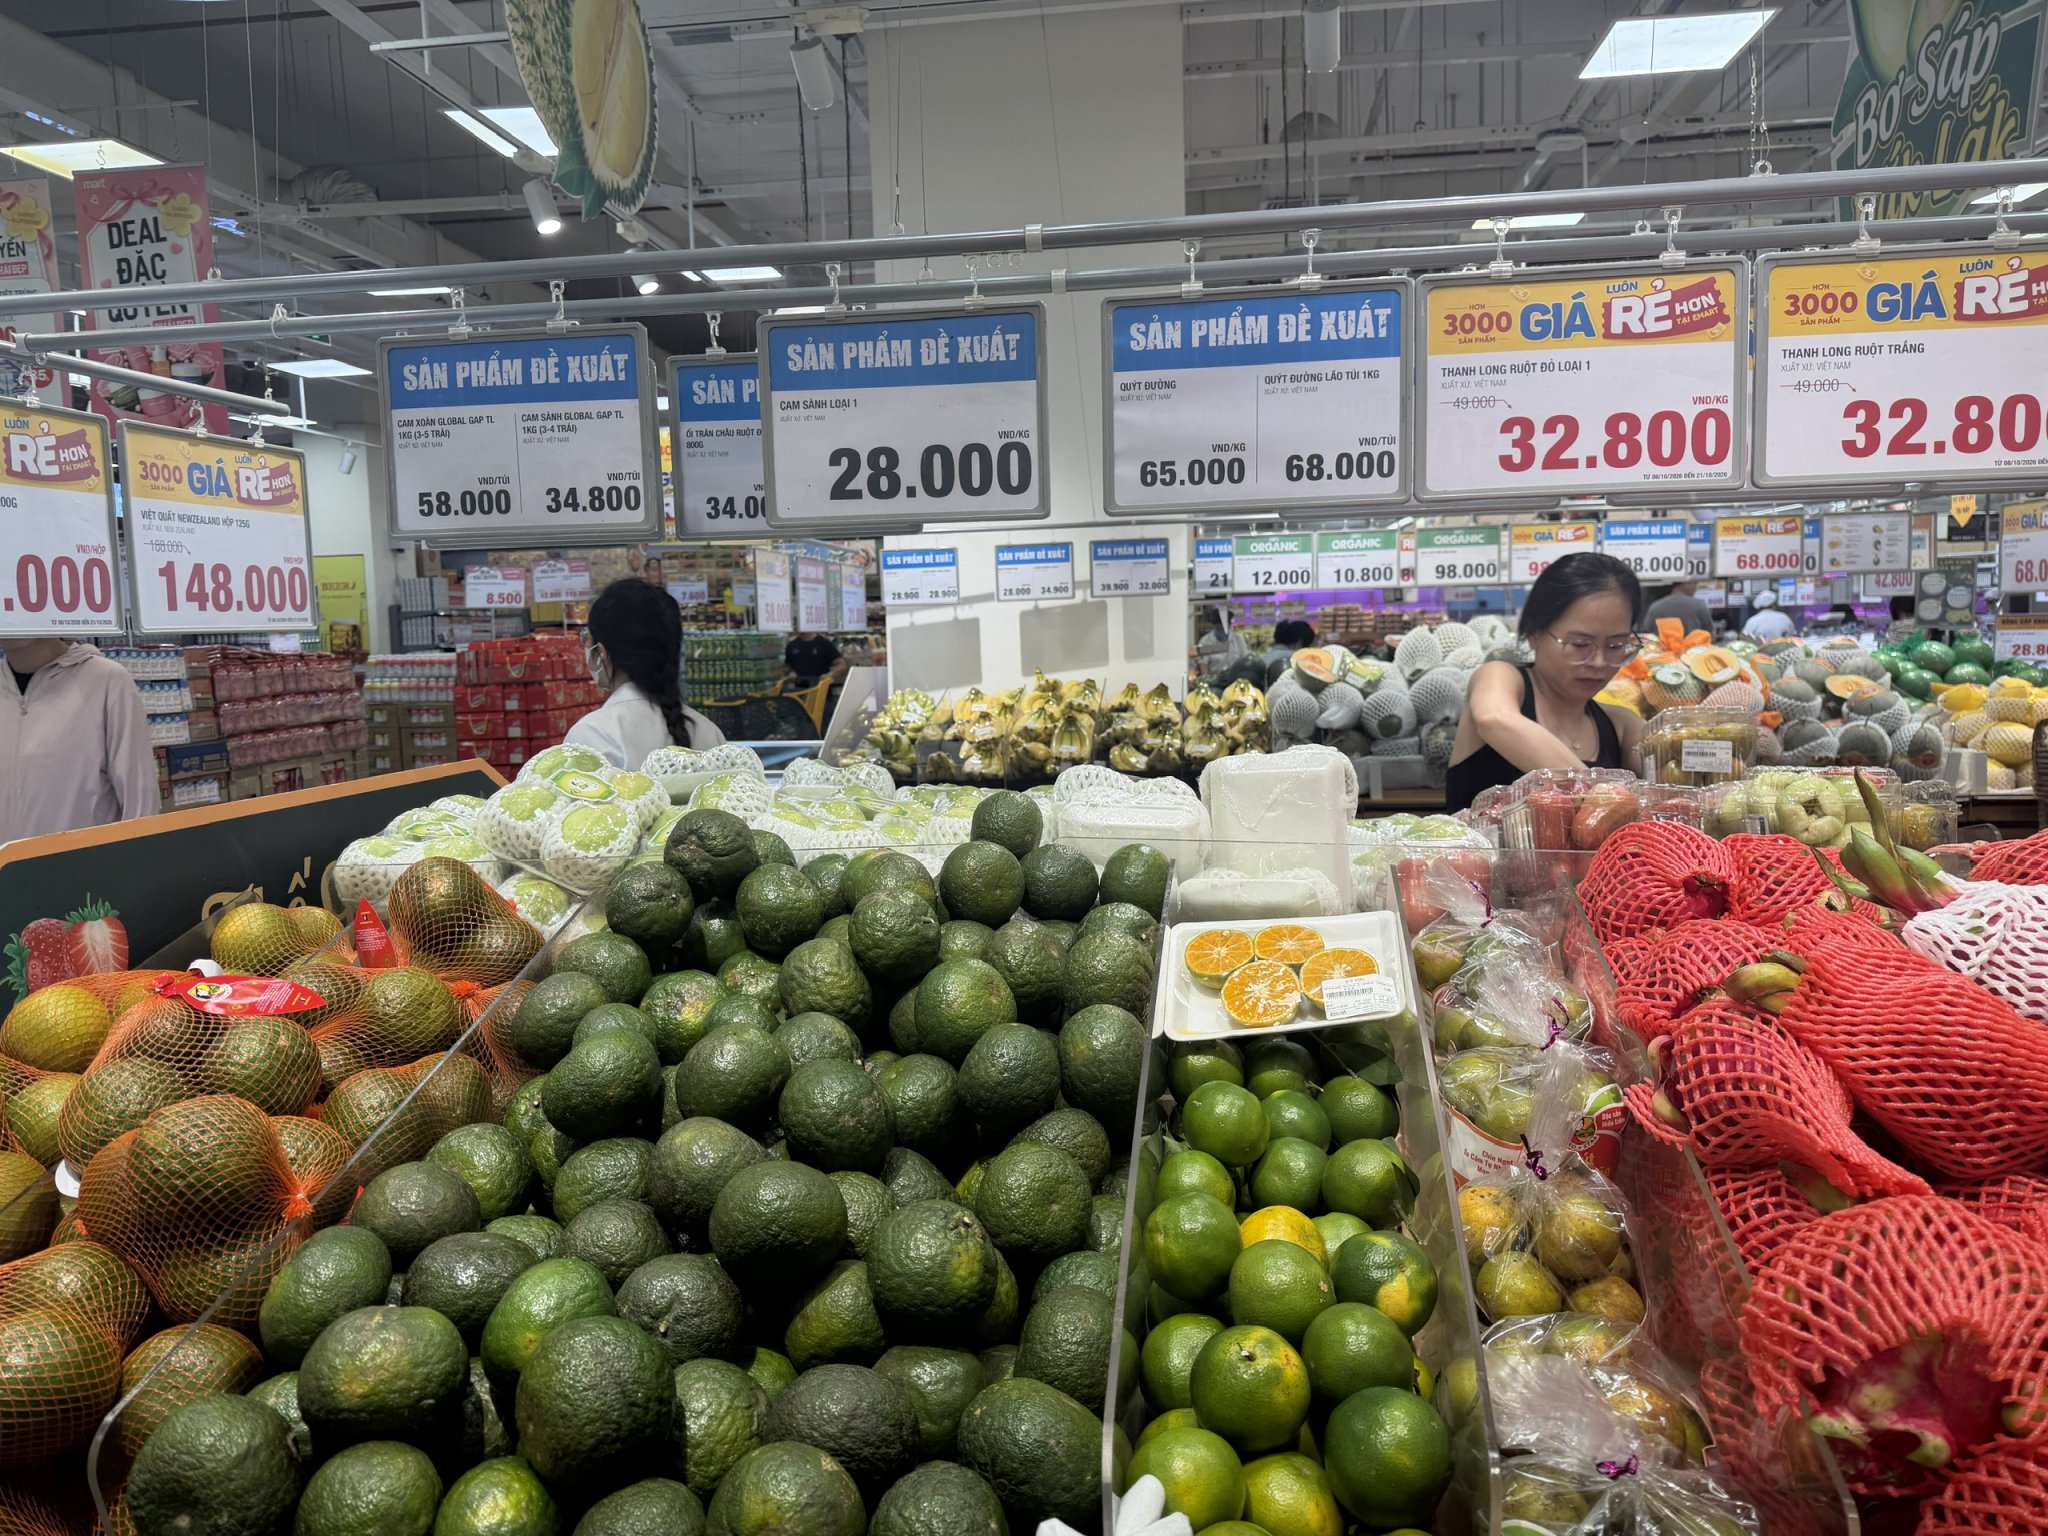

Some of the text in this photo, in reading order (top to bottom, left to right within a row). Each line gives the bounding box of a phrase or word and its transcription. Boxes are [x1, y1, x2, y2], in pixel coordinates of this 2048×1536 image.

[1855, 9, 2000, 168] Bơ Sáp
[107, 215, 168, 250] DEAL
[116, 249, 167, 286] ĐẶC
[1959, 258, 1994, 274] LUÔN
[1606, 280, 1639, 295] LUÔN
[1812, 283, 1830, 291] HƠN
[1962, 255, 2030, 316] RẺ
[1675, 292, 1716, 316] HƠN
[1866, 269, 1948, 323] GIÁ
[1468, 303, 1486, 311] HƠN
[1610, 277, 1673, 335] RẺ
[1519, 291, 1597, 341] GIÁ
[1676, 306, 1719, 327] TẠI EMART
[1799, 315, 1841, 326] SẢN PHẨM
[1129, 299, 1392, 351] SẢN PHẨM ĐỀ XUẤT
[787, 324, 1021, 373] SẢN PHẨM ĐỀ XUẤT
[1458, 335, 1496, 345] SẢN PHẨM
[1782, 340, 1926, 360] THANH LONG RUỘT TRẮNG
[403, 345, 628, 391] SẢN PHẨM ĐỀ XUẤT
[1441, 358, 1591, 378] THANH LONG RUỘT ĐỎ LOẠI 1
[1780, 361, 1799, 372] XUẤT
[1816, 360, 1833, 372] VIỆT
[1834, 360, 1851, 370] NAM
[1120, 378, 1177, 392] QUÝT ĐƯỜNG
[1264, 372, 1289, 386] QUÝT
[1289, 370, 1323, 384] ĐƯỜNG
[1344, 367, 1360, 380] TÚI
[1361, 369, 1380, 380] 1KG
[1440, 379, 1459, 390] XUẤT
[1474, 378, 1489, 389] VIỆT
[1490, 378, 1507, 388] NAM
[692, 373, 735, 406] SẢN
[1793, 378, 1840, 394] 49.000
[780, 396, 858, 413] CAM SÀNH LOẠI 1
[1453, 395, 1496, 410] 49.000
[1691, 395, 1729, 407] VND/KG
[4, 418, 29, 430] LUÔN
[397, 415, 496, 428] CAM XOÀN GLOBAL GAP TL
[521, 410, 625, 422] CAM SÀNH GLOBAL GAP TL
[521, 422, 579, 435] 1KG (3-4 TRÁI)
[715, 427, 735, 438] CHÂU
[736, 427, 755, 440] RUỘT
[1840, 393, 2048, 459] 32.80
[398, 431, 413, 440] 1KG
[413, 430, 430, 441] (3-5
[998, 429, 1030, 441] VND/KG
[1358, 434, 1397, 448] VND/TÚI
[1498, 408, 1732, 474] 32.800
[8, 420, 57, 476] RẺ
[58, 443, 89, 463] HƠN
[686, 440, 704, 449] 800G
[1211, 442, 1246, 454] VND/KG
[235, 453, 252, 464] LUÔN
[1285, 450, 1397, 482] 68.000
[186, 457, 233, 499] GIÁ
[238, 455, 273, 501] RẺ
[477, 472, 511, 486] VND/TÚI
[606, 468, 642, 482] VND/TÚI
[828, 441, 1032, 501] 28.000
[1139, 457, 1246, 488] 65.000
[271, 475, 292, 489] HƠN
[418, 489, 512, 518] 58.000
[545, 485, 642, 514] 34.800
[141, 509, 250, 529] VIỆT QUẤT NEWZEALAND HỘP 125G
[1743, 521, 1763, 535] GIÁ
[150, 538, 183, 554] 188.000
[1250, 541, 1299, 553] ORGANIC
[1331, 537, 1381, 550] ORGANIC
[1433, 533, 1486, 545] ORGANIC
[76, 543, 107, 558] VND/HỘP
[1736, 553, 1800, 570] 68.000
[1251, 569, 1311, 586] 12.000
[1334, 566, 1394, 583] 10.800
[1435, 562, 1497, 580] 98.000
[158, 560, 308, 613] 148.000
[486, 591, 522, 605] 8.500
